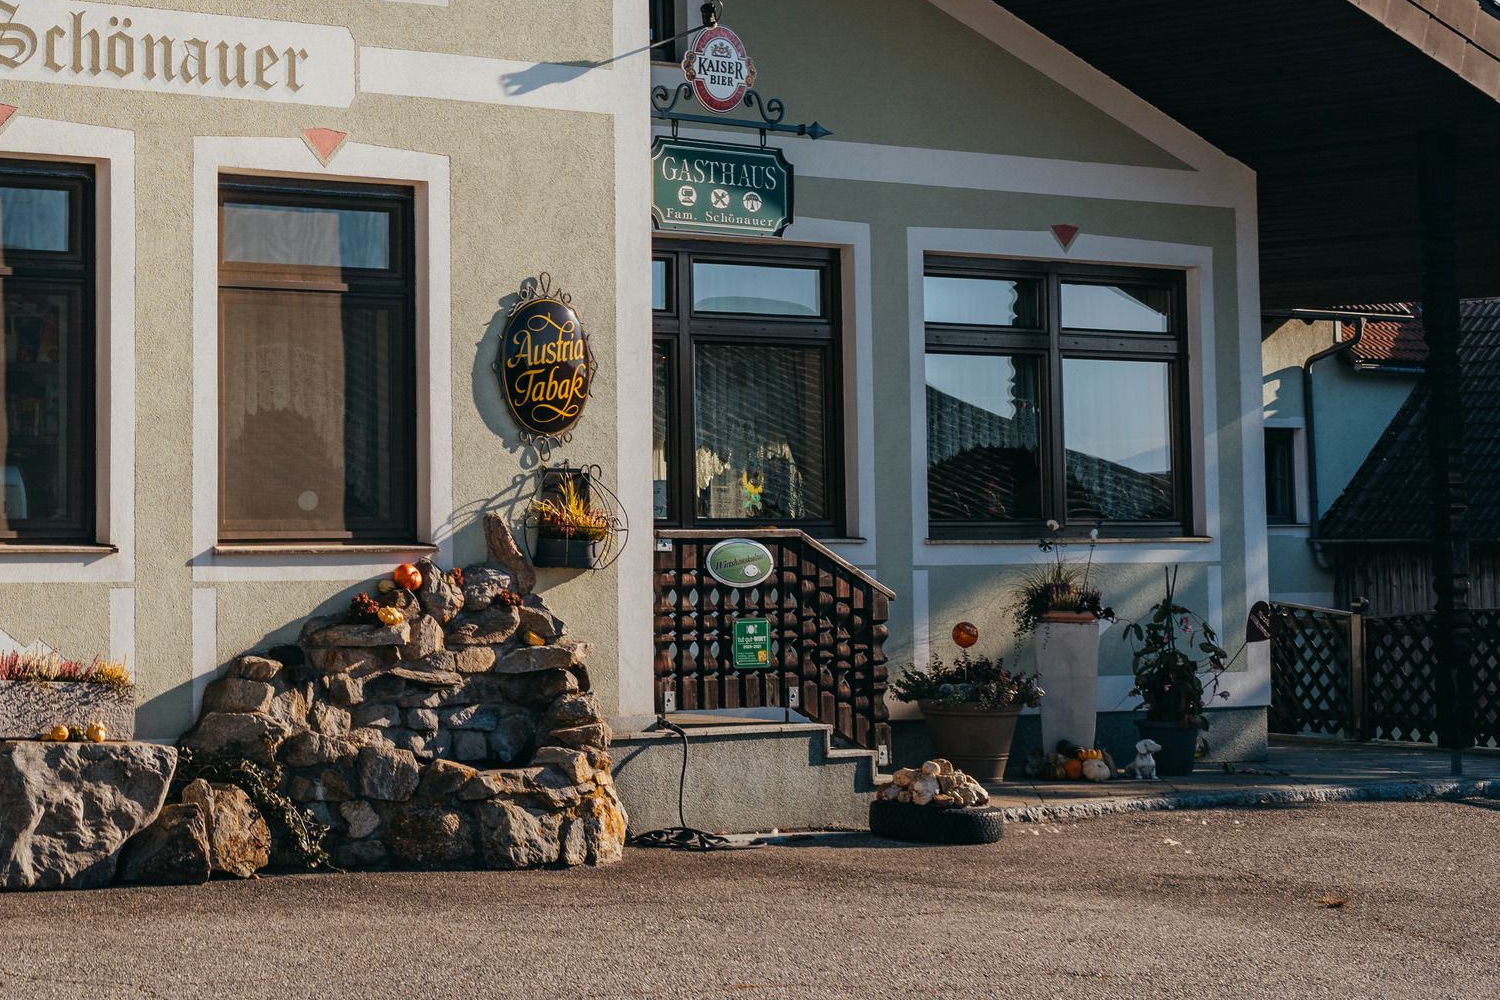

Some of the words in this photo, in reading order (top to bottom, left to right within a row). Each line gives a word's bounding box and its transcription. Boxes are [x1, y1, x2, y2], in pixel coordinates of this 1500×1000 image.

[698, 56, 744, 81] KAISER
[710, 74, 734, 87] BIER
[661, 156, 777, 191] GASTHAUS
[666, 207, 698, 221] Fam.
[705, 210, 775, 227] Schönauer
[507, 312, 585, 369] Austria
[514, 363, 587, 422] Tabak
